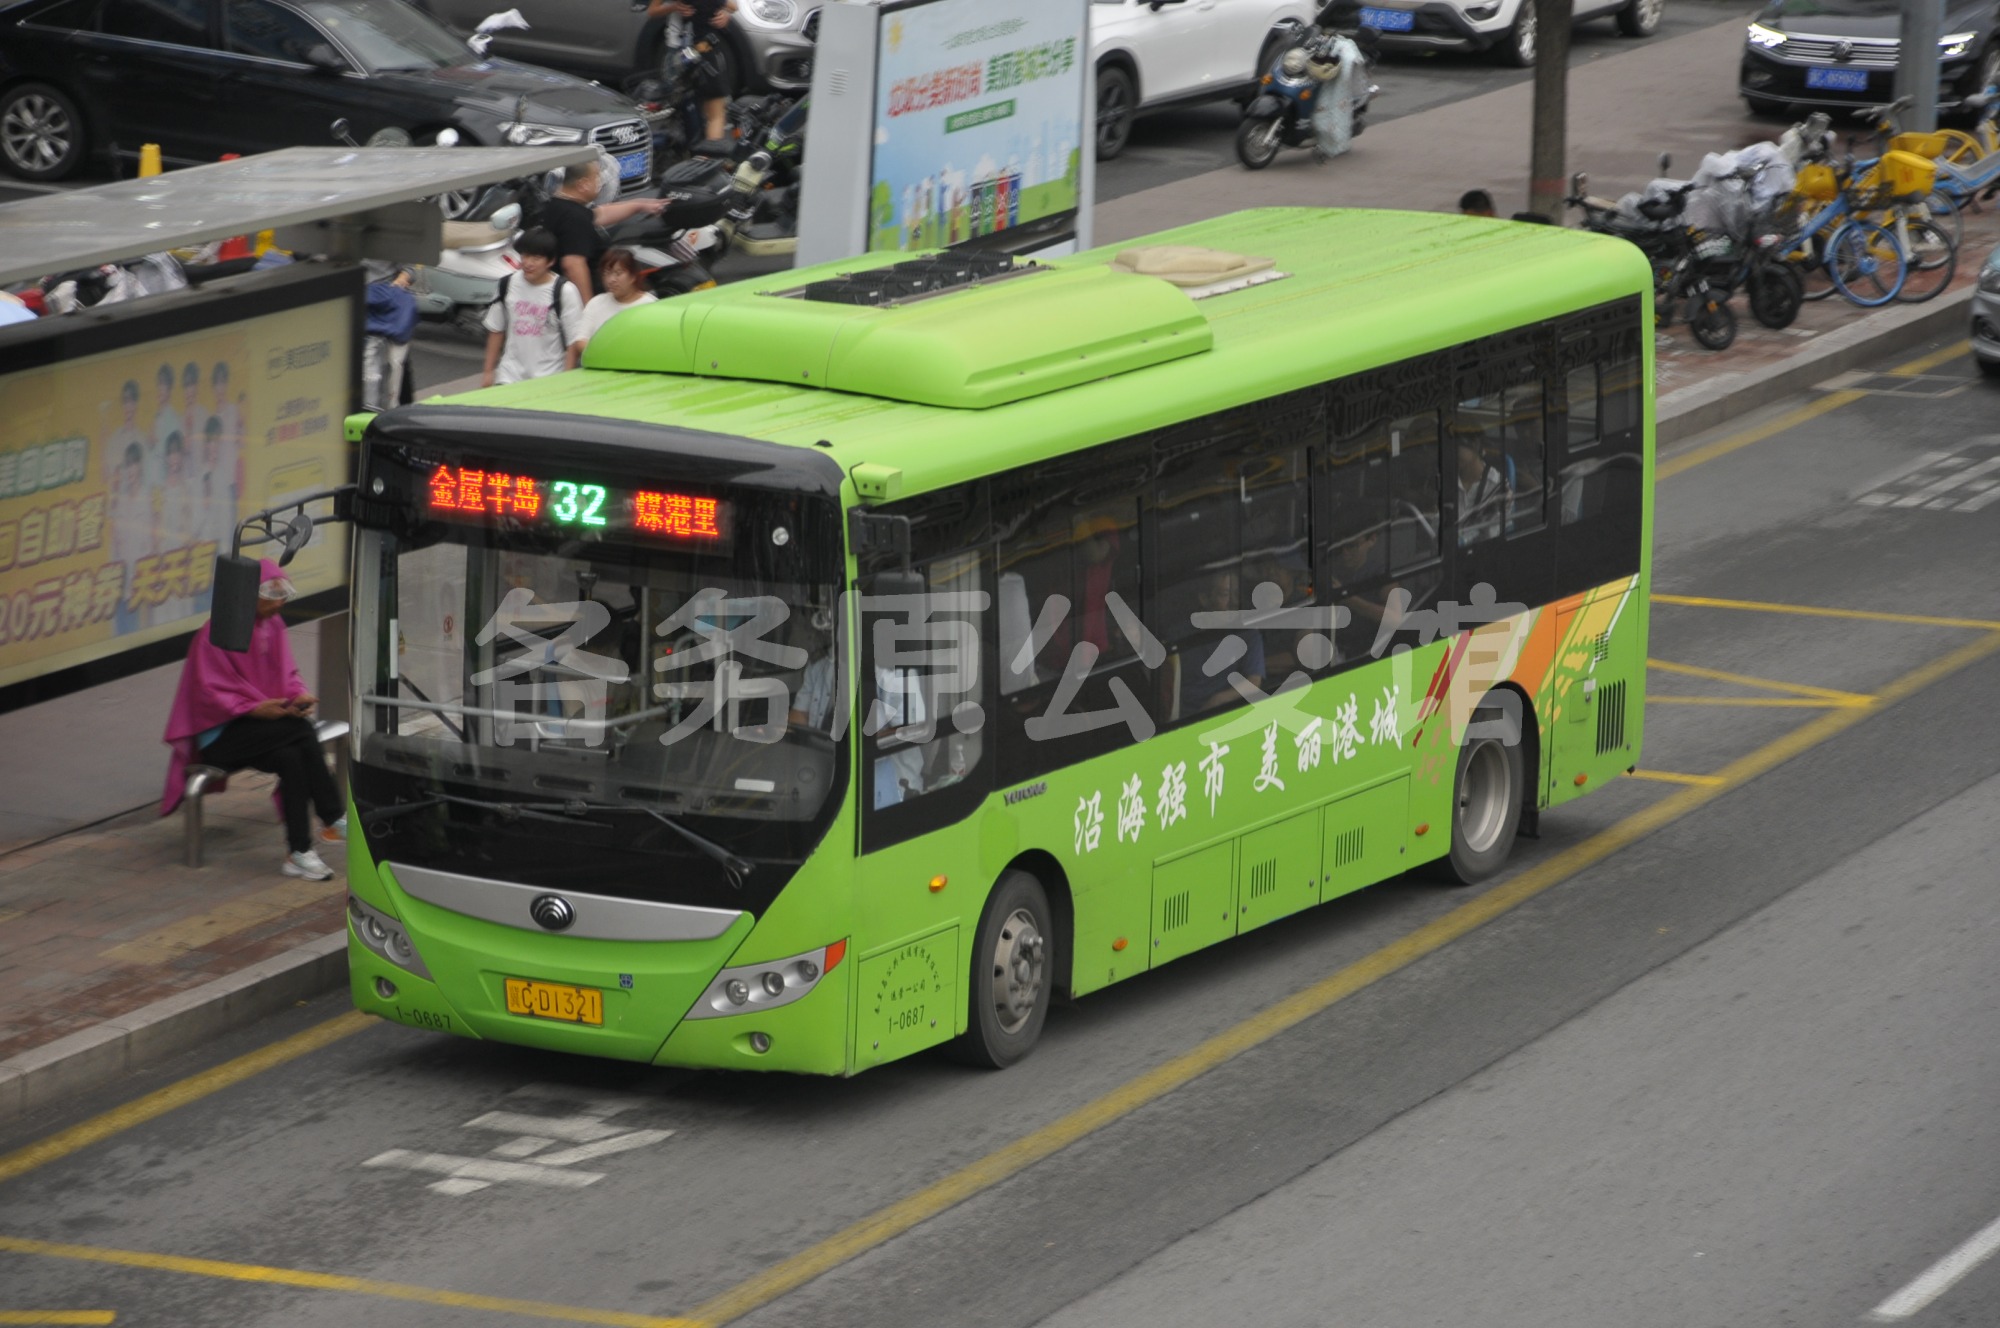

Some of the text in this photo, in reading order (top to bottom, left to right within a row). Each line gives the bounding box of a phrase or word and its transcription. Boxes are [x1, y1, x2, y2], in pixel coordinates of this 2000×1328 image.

[430, 465, 540, 516] 金屋半岛
[553, 481, 606, 525] 32
[1074, 684, 1403, 856] 沿海强市 美丽港城
[396, 1005, 450, 1029] 1-0687
[888, 1004, 925, 1034] 1-0687
